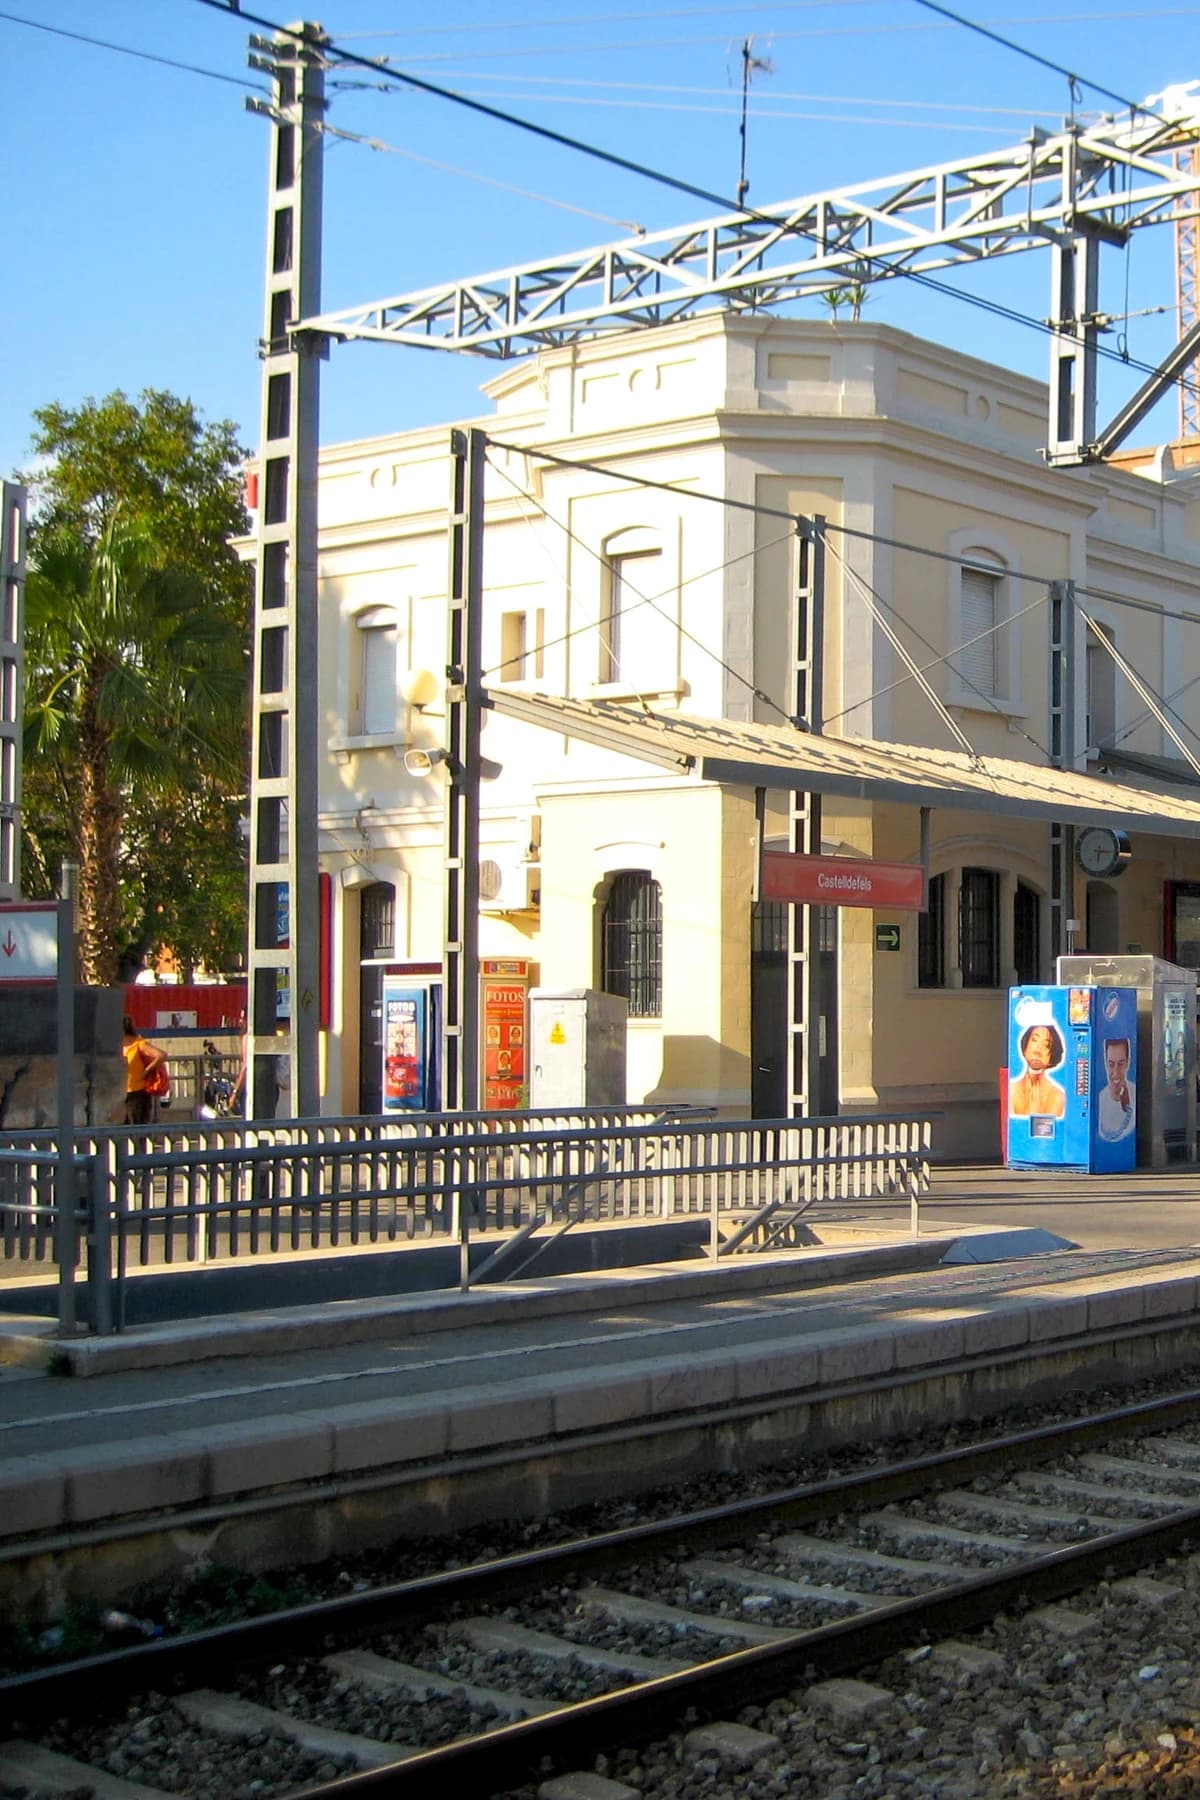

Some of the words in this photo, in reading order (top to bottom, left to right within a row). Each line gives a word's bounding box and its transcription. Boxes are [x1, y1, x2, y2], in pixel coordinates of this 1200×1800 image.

[817, 872, 872, 891] Castelldefels
[486, 991, 524, 1003] FOTOS
[388, 1002, 415, 1012] FOTOS
